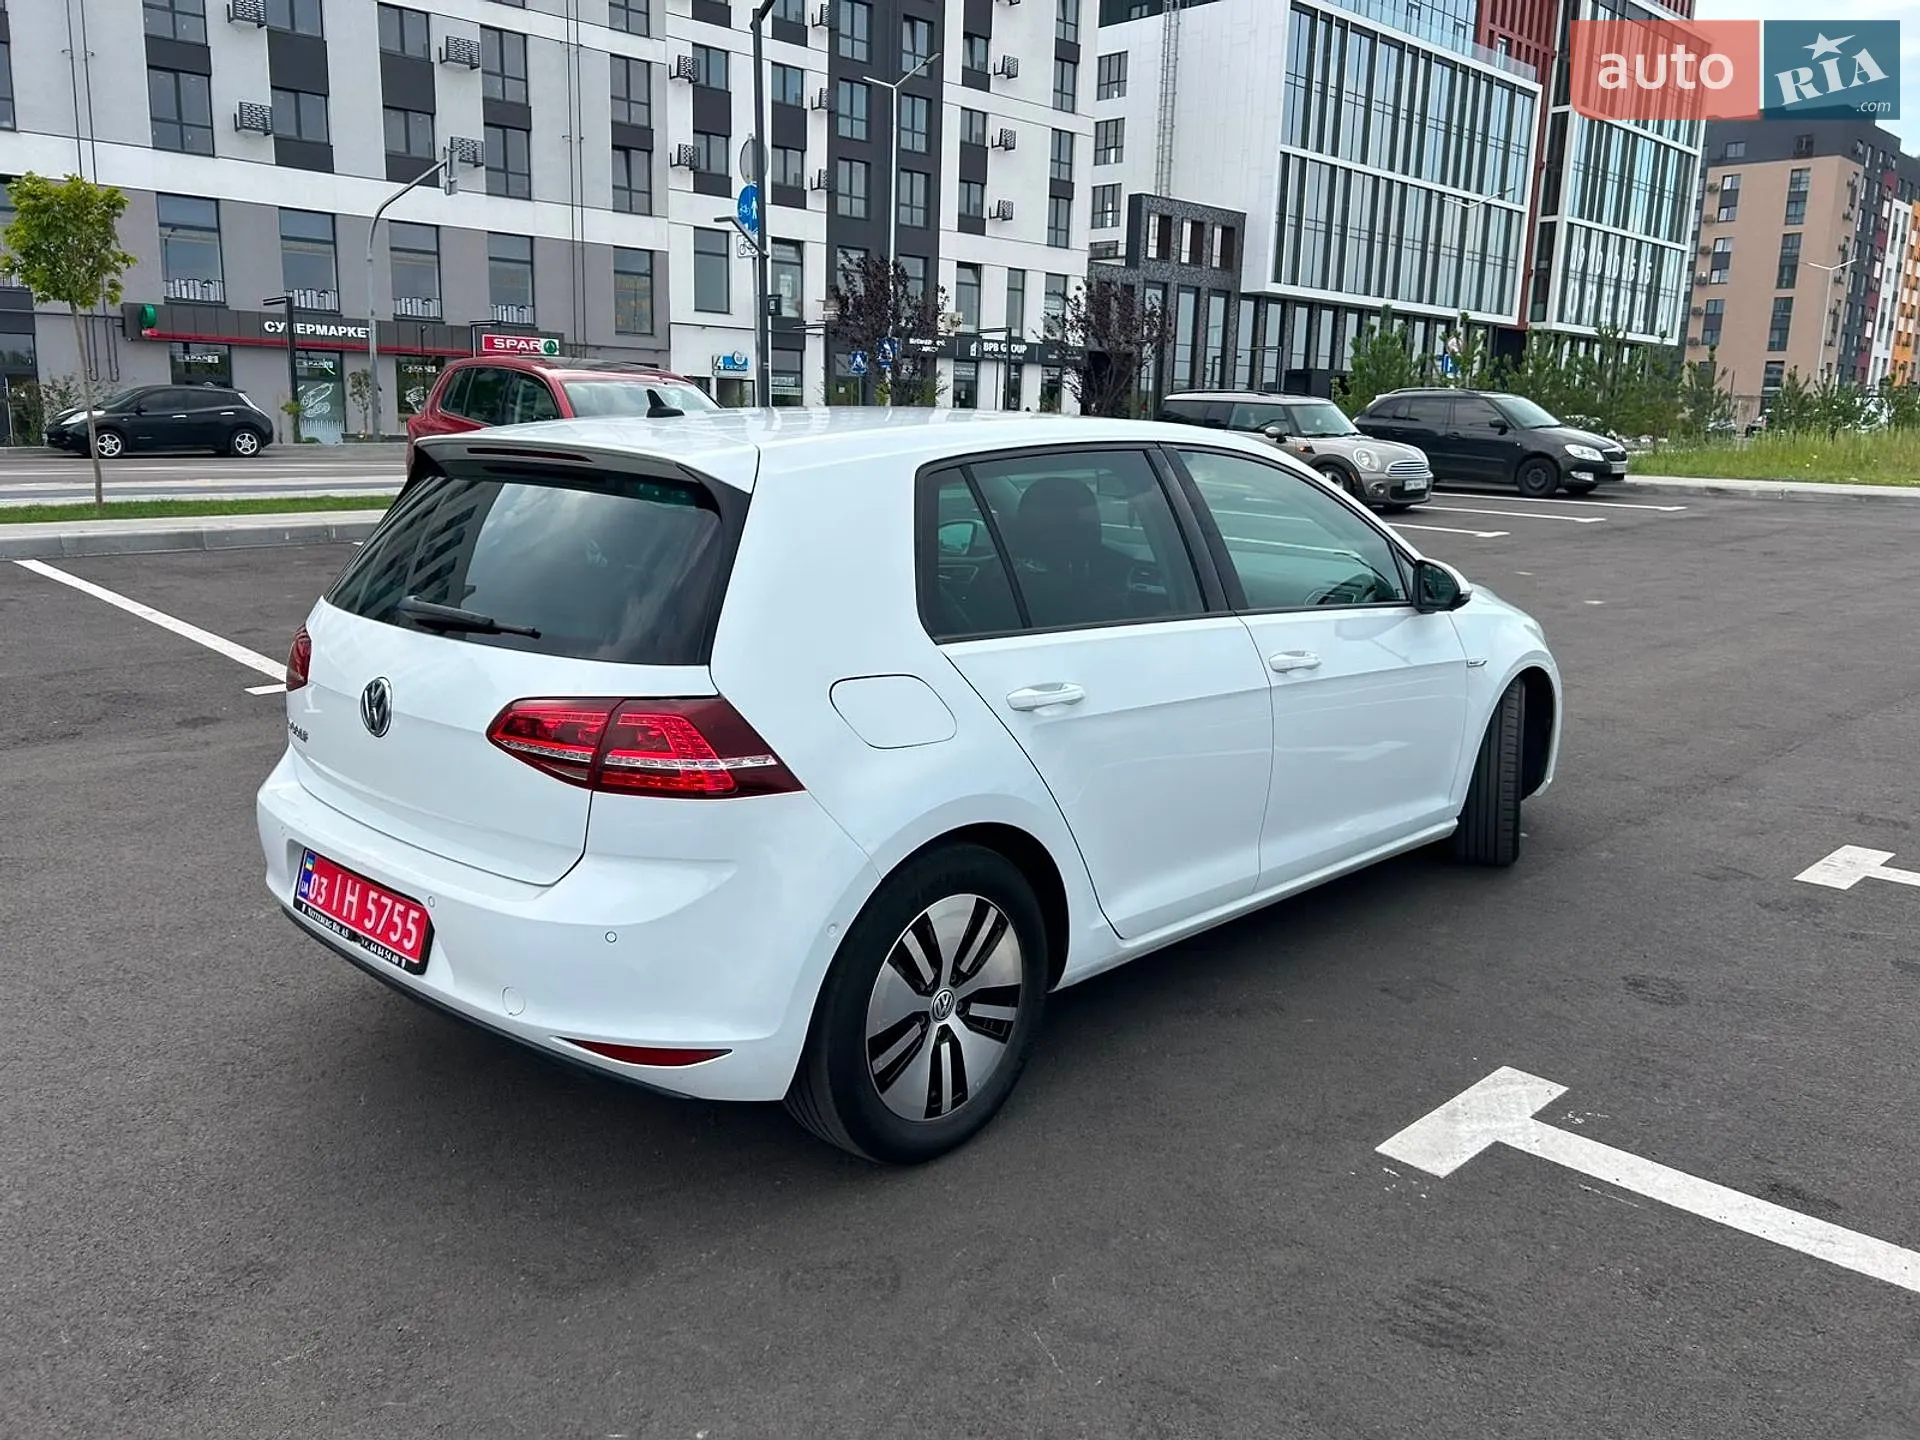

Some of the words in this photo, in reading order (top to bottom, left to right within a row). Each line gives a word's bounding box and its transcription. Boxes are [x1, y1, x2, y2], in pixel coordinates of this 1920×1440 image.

[264, 321, 369, 338] СУЕРМАРКЕ
[494, 338, 540, 350] SPAR
[1000, 343, 1027, 358] GOUP
[308, 873, 328, 905] 03
[363, 889, 420, 951] 5755
